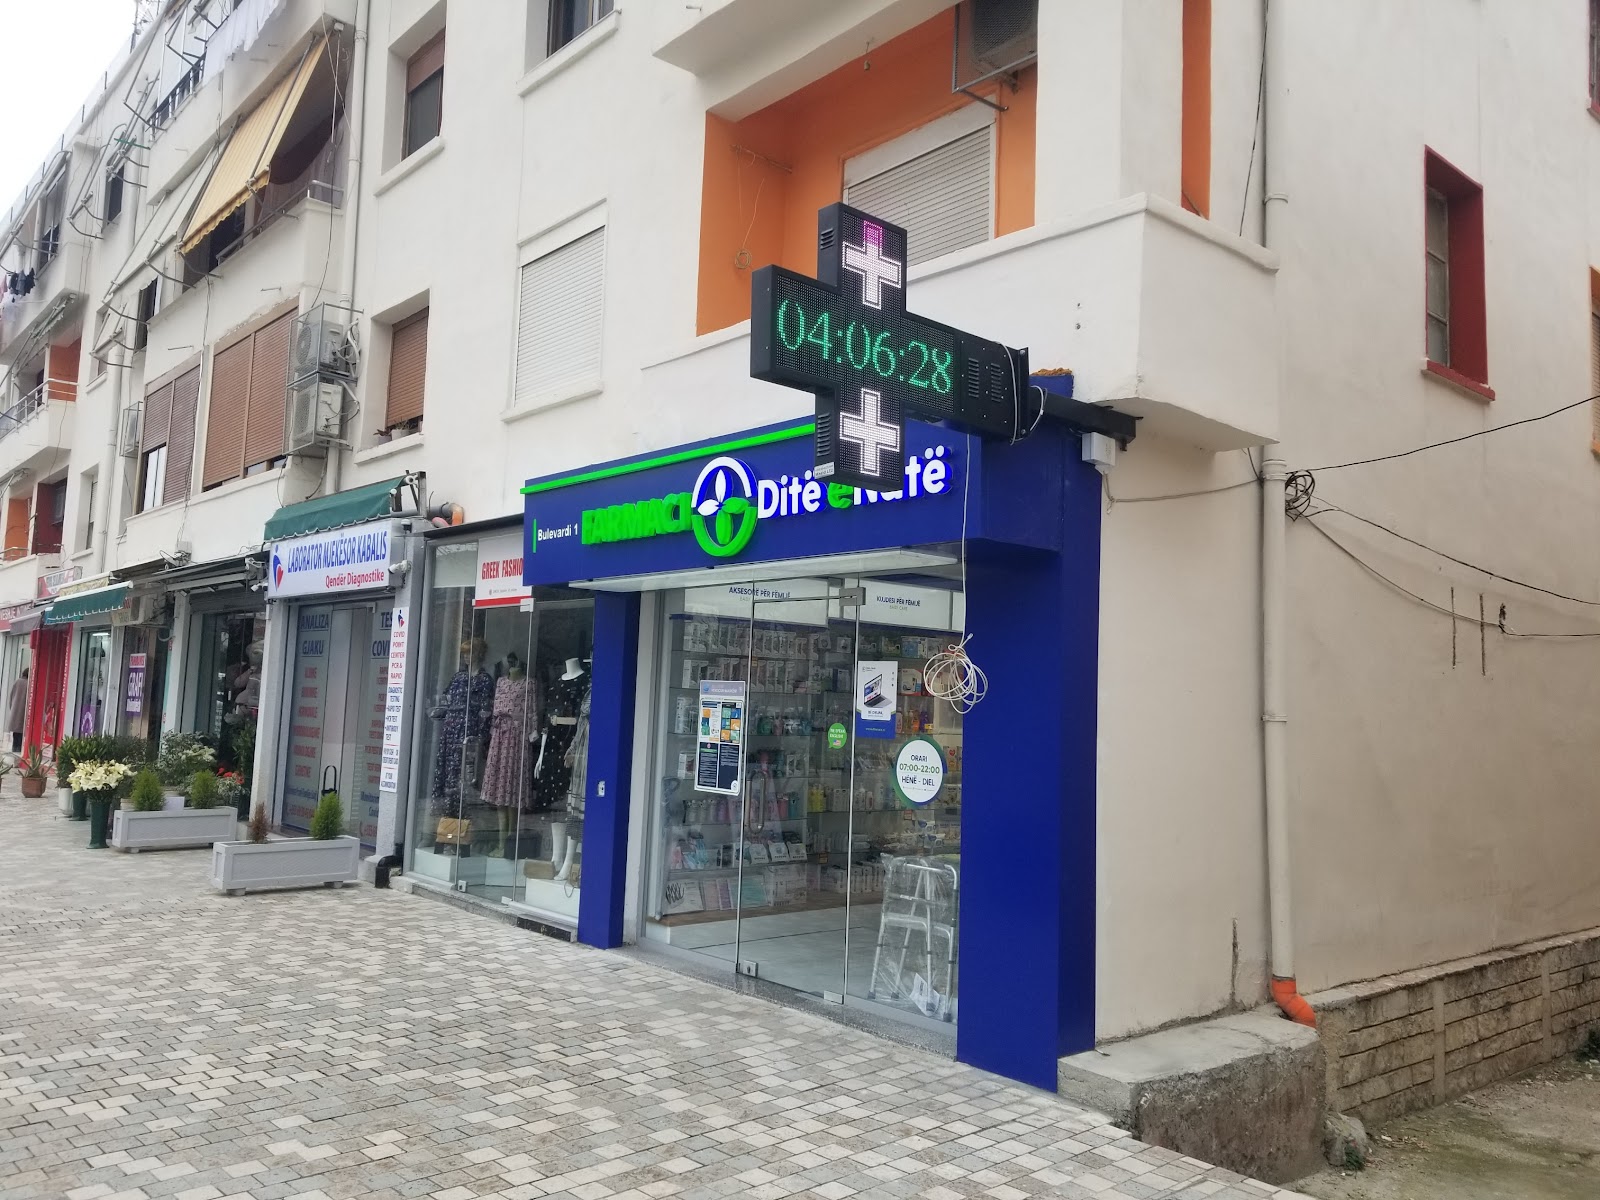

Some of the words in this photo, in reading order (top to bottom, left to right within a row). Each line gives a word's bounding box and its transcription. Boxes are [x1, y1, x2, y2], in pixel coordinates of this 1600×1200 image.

[777, 300, 951, 394] 04:06:28
[757, 469, 824, 519] Ditë
[827, 482, 854, 509] e
[582, 492, 693, 545] FARMACI
[537, 524, 572, 541] Bulevardi
[573, 522, 578, 536] 1
[287, 543, 323, 574] LABORATOR
[356, 530, 388, 564] KABALIS
[481, 561, 500, 580] GREEK
[501, 557, 524, 578] FASHIO
[325, 572, 347, 589] Qendër
[347, 568, 385, 588] Diagnostike
[300, 614, 329, 630] ANALIZA
[380, 611, 393, 628] TES
[302, 640, 324, 656] GJAKU
[371, 640, 391, 657] COVI
[390, 651, 405, 659] CENTER
[390, 672, 403, 680] RAPID
[910, 754, 928, 763] ORARI
[899, 762, 941, 774] 07:00-22:00
[922, 777, 935, 787] DIEL
